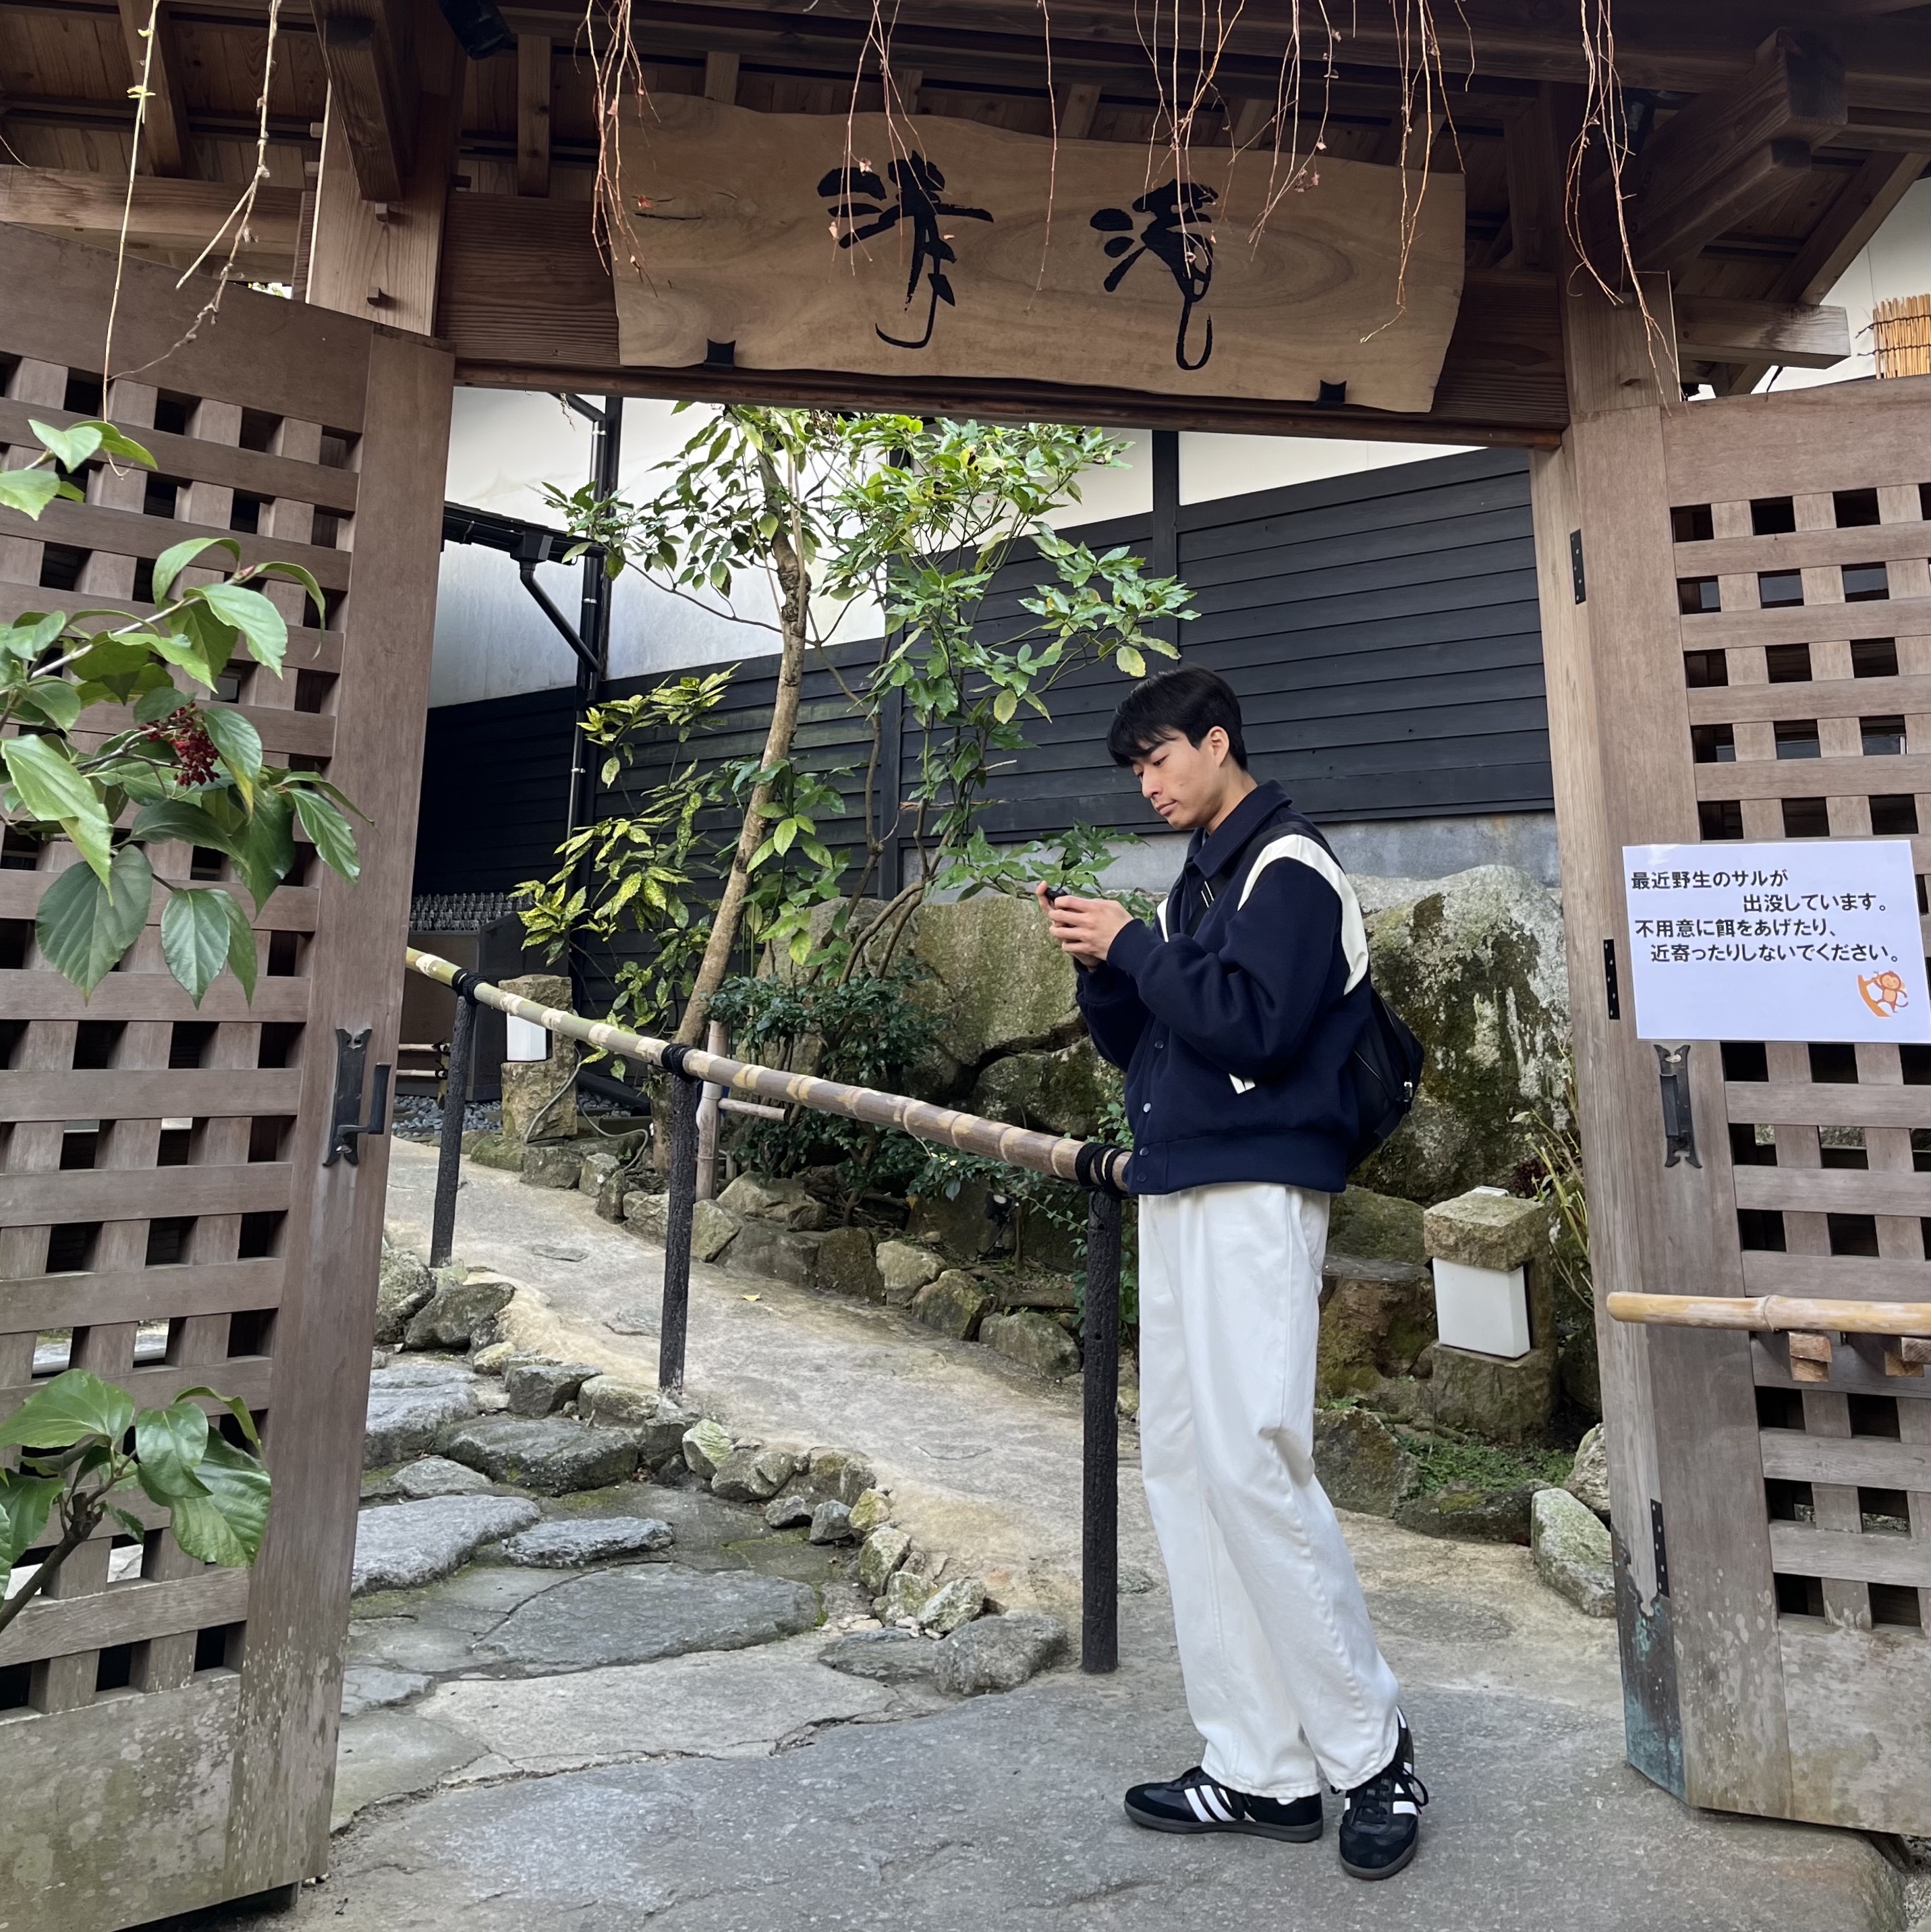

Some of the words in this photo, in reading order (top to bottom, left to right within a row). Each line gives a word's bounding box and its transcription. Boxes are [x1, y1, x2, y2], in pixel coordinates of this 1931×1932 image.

[1631, 869, 1789, 890] 最近野生のサルが
[1743, 892, 1887, 913] 出没しています。
[1635, 918, 1837, 938] 不用意に餌をあげたり、
[1650, 943, 1899, 963] 近寄ったりしないでください。
